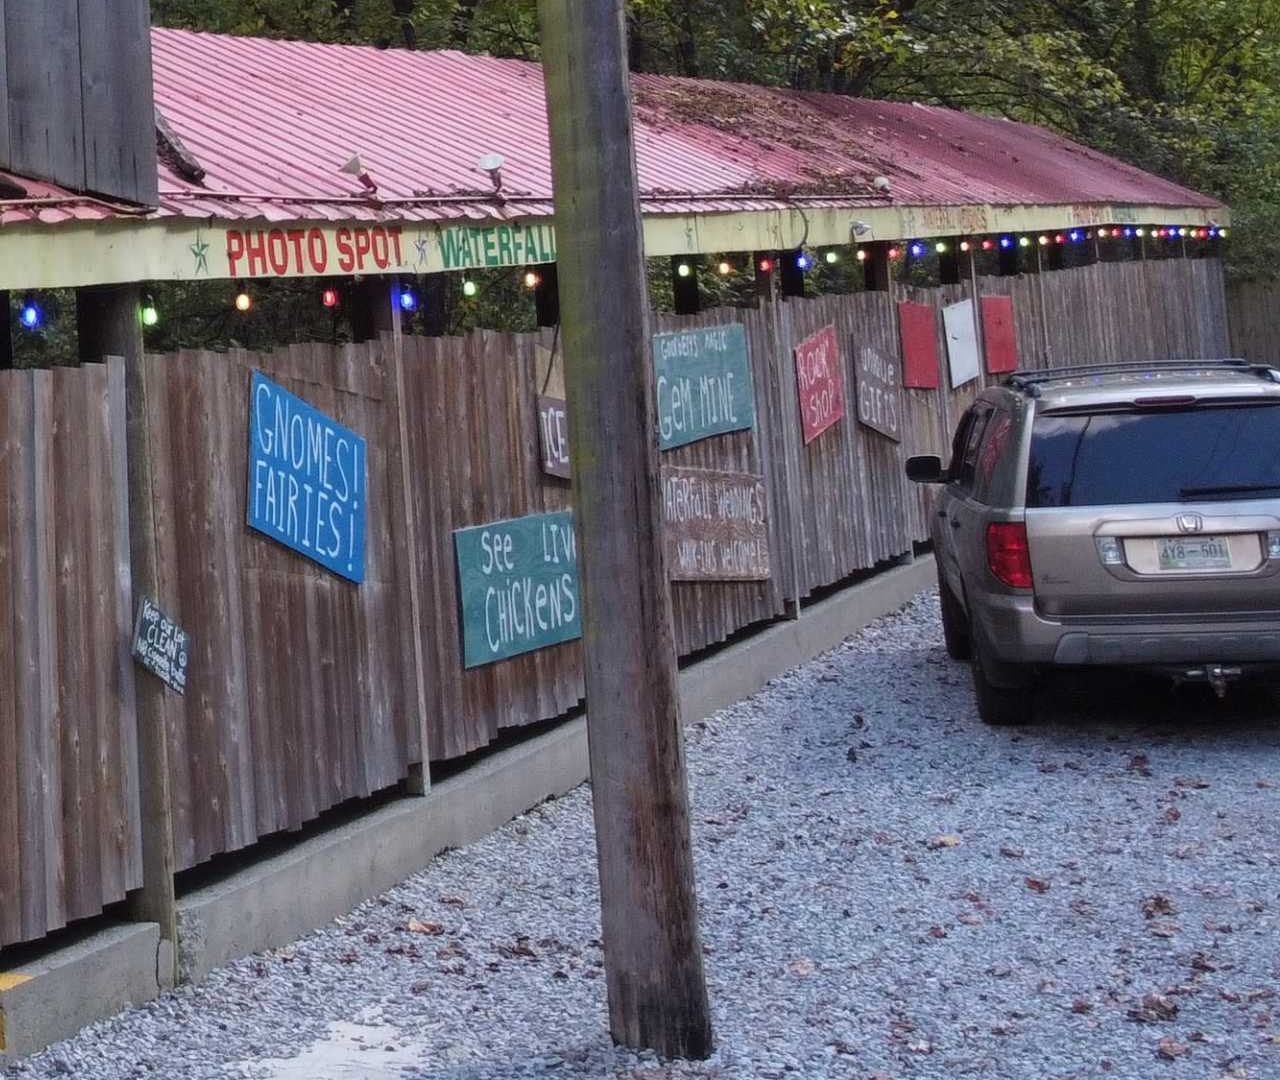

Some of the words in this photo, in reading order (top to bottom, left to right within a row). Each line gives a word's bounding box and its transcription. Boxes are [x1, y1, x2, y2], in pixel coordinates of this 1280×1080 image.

[227, 227, 327, 277] PHOTO
[336, 224, 406, 272] SPOT
[699, 371, 738, 429] MINE
[255, 383, 367, 506] GNOMES!
[254, 460, 360, 572] FAIRIES!
[147, 624, 177, 661] CLEAN
